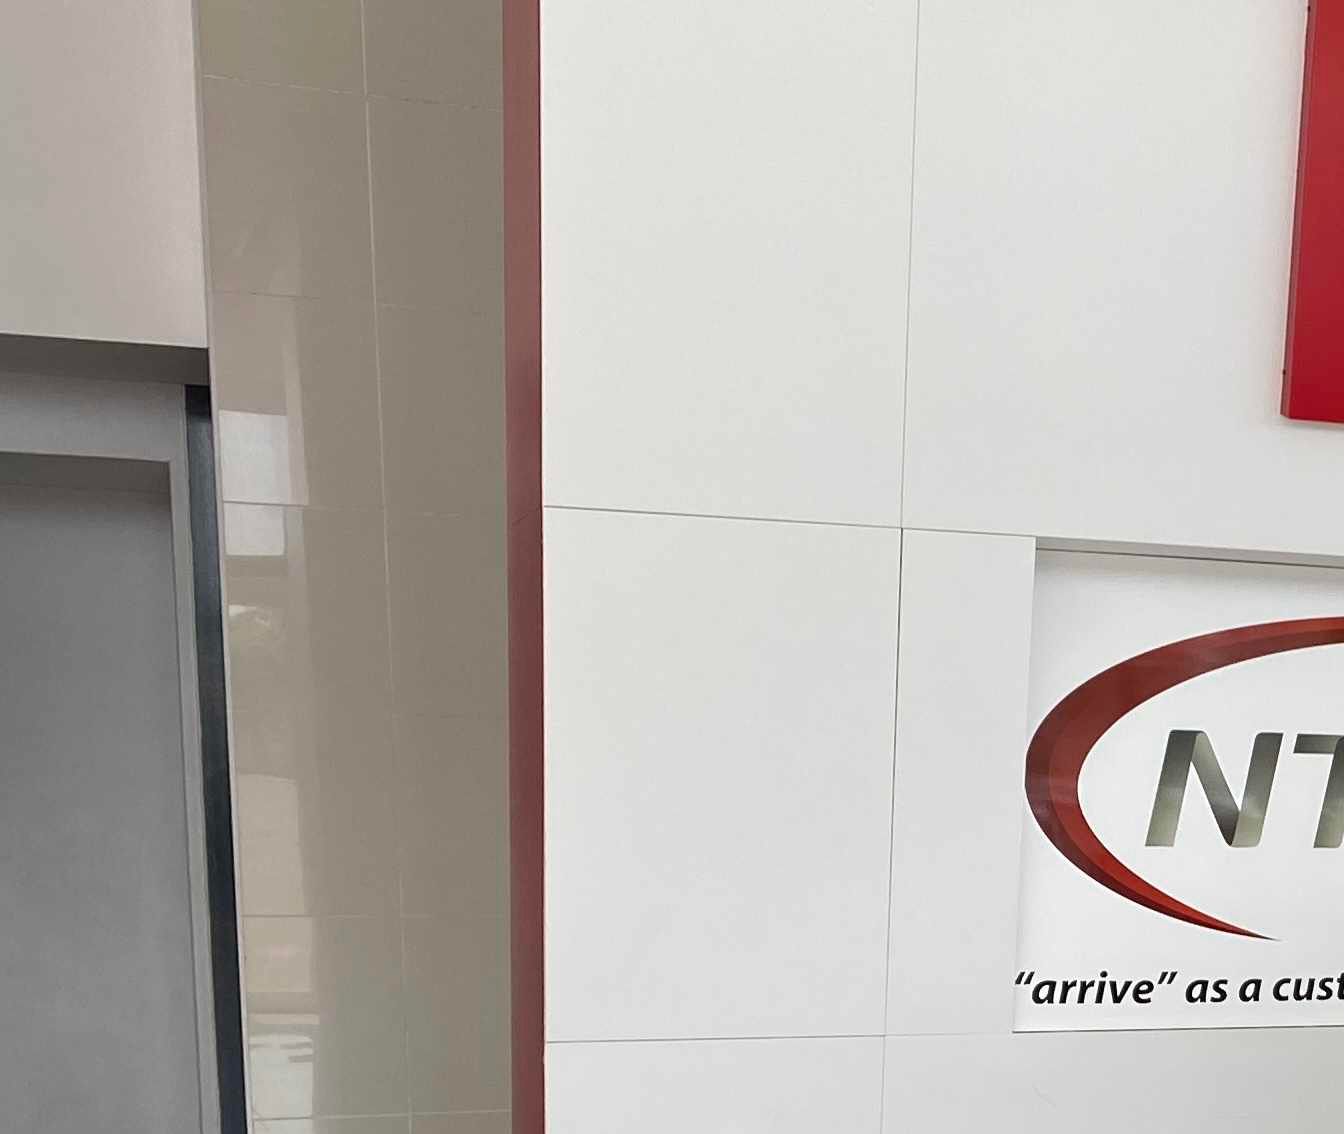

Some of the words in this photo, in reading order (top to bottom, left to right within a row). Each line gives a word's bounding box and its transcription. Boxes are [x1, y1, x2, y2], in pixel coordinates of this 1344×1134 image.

[1013, 970, 1178, 1005] “arrive”
[1184, 978, 1229, 1004] as
[1238, 978, 1263, 1003] a
